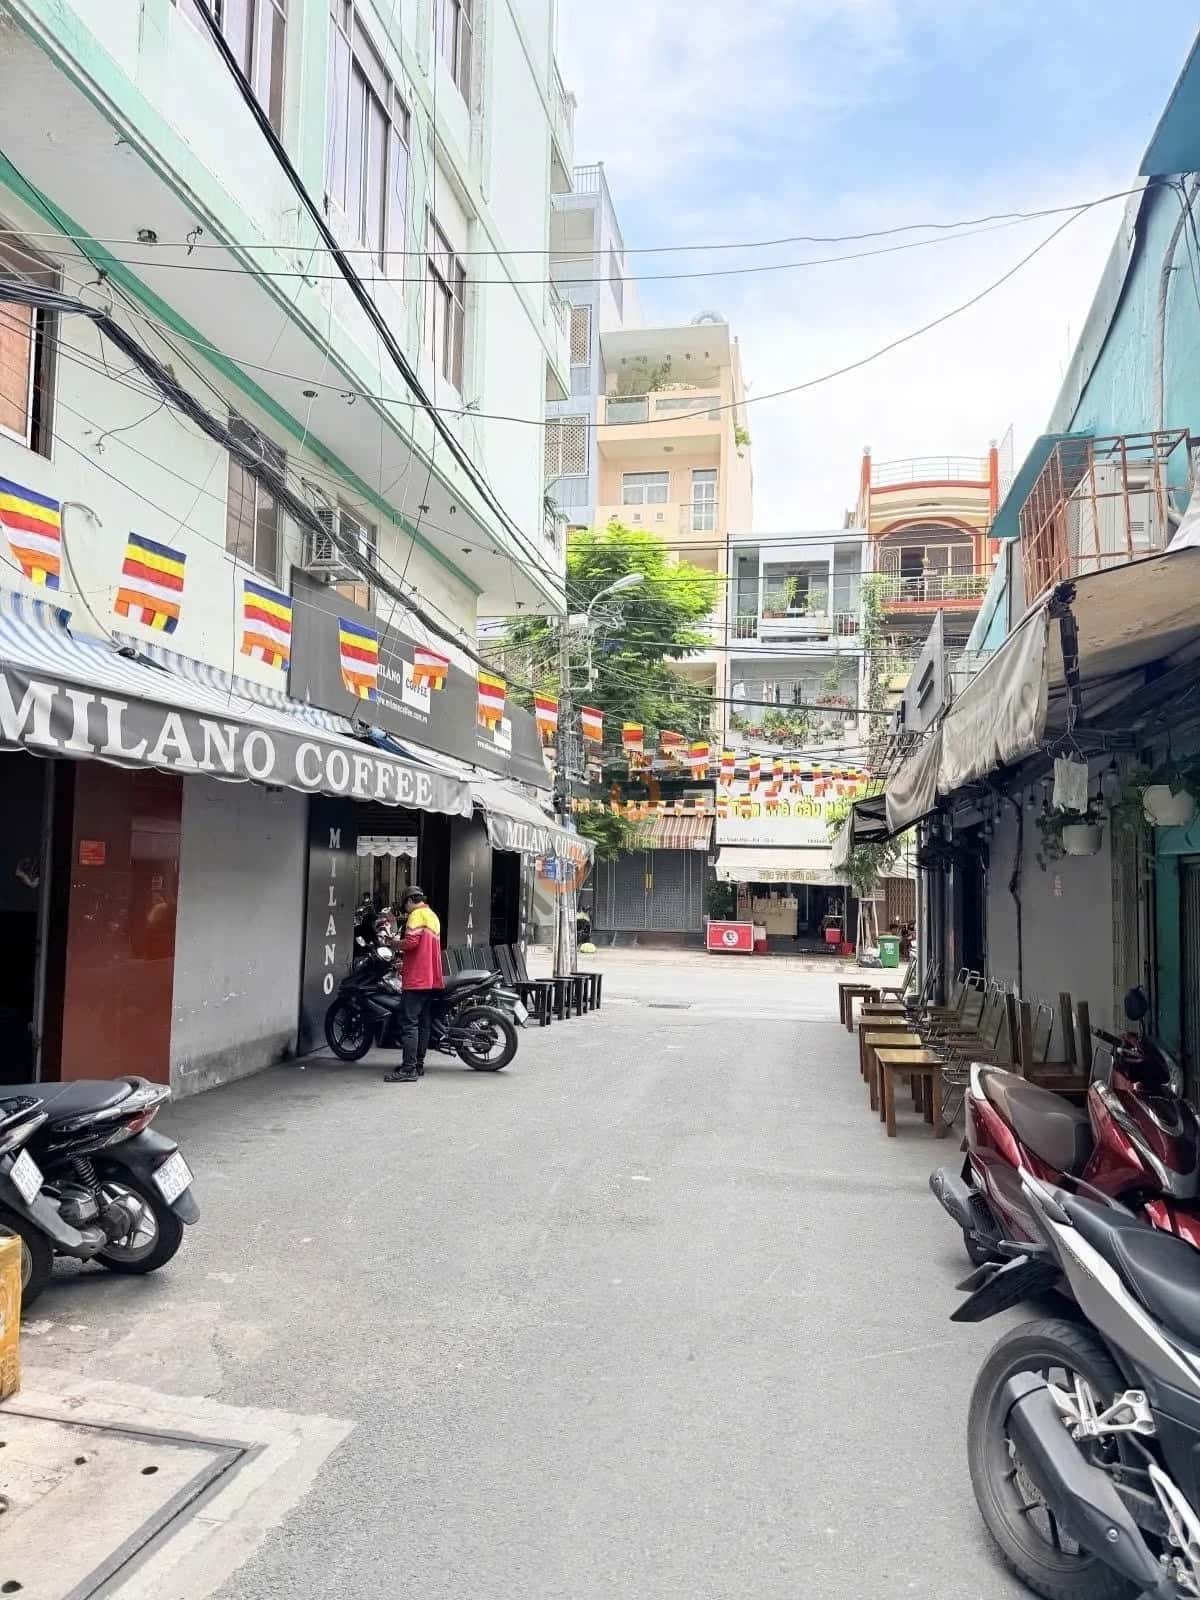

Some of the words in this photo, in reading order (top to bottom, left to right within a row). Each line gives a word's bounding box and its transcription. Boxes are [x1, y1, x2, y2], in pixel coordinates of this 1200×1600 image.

[0, 673, 276, 778] MILANO
[295, 743, 433, 807] COFFEE
[377, 663, 401, 684] ILANO
[323, 827, 341, 995] MILANO
